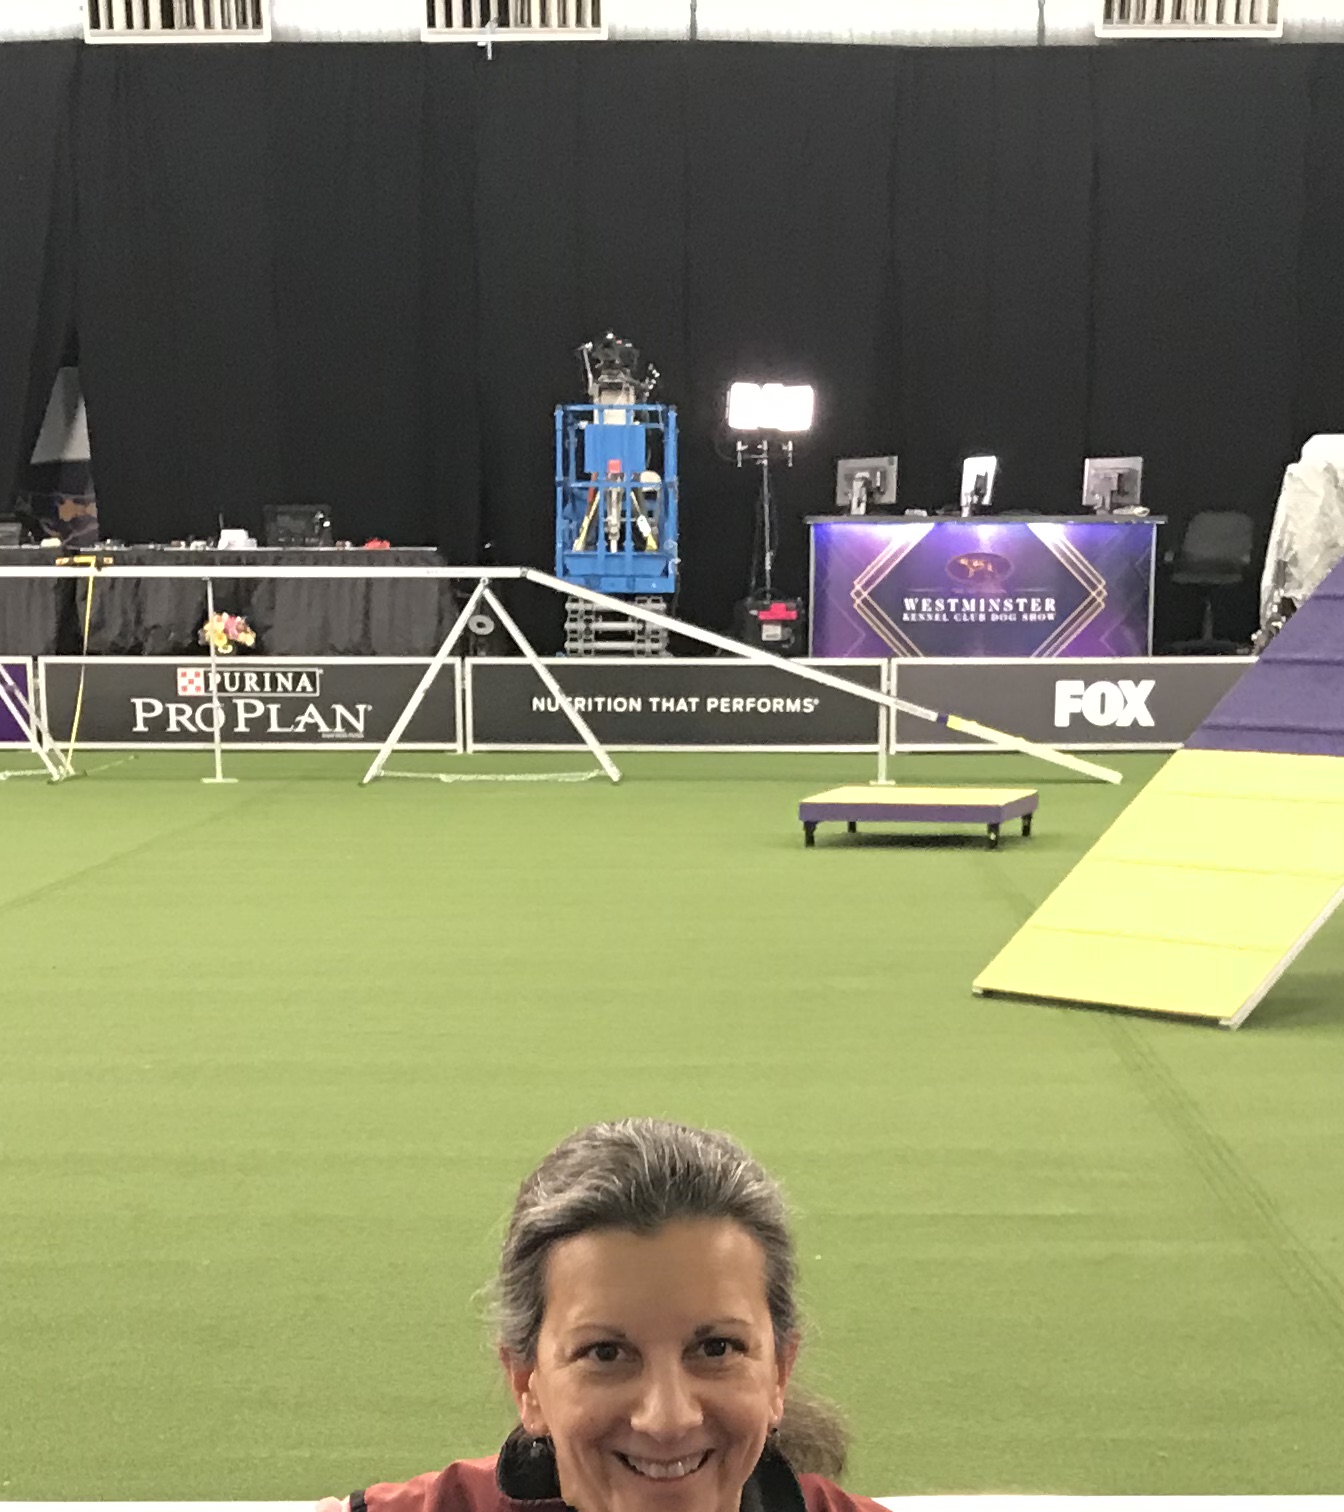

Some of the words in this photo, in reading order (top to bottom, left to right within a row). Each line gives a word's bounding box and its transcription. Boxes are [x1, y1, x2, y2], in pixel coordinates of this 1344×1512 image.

[903, 598, 1056, 612] WESTMINSTER
[953, 613, 986, 622] CLUB
[990, 613, 1017, 622] DOG
[1022, 613, 1056, 622] SHOW
[208, 672, 314, 692] PURINA
[649, 696, 700, 713] THAT
[1055, 680, 1156, 727] FOX
[130, 698, 226, 733] PRO
[232, 698, 367, 733] PLAN
